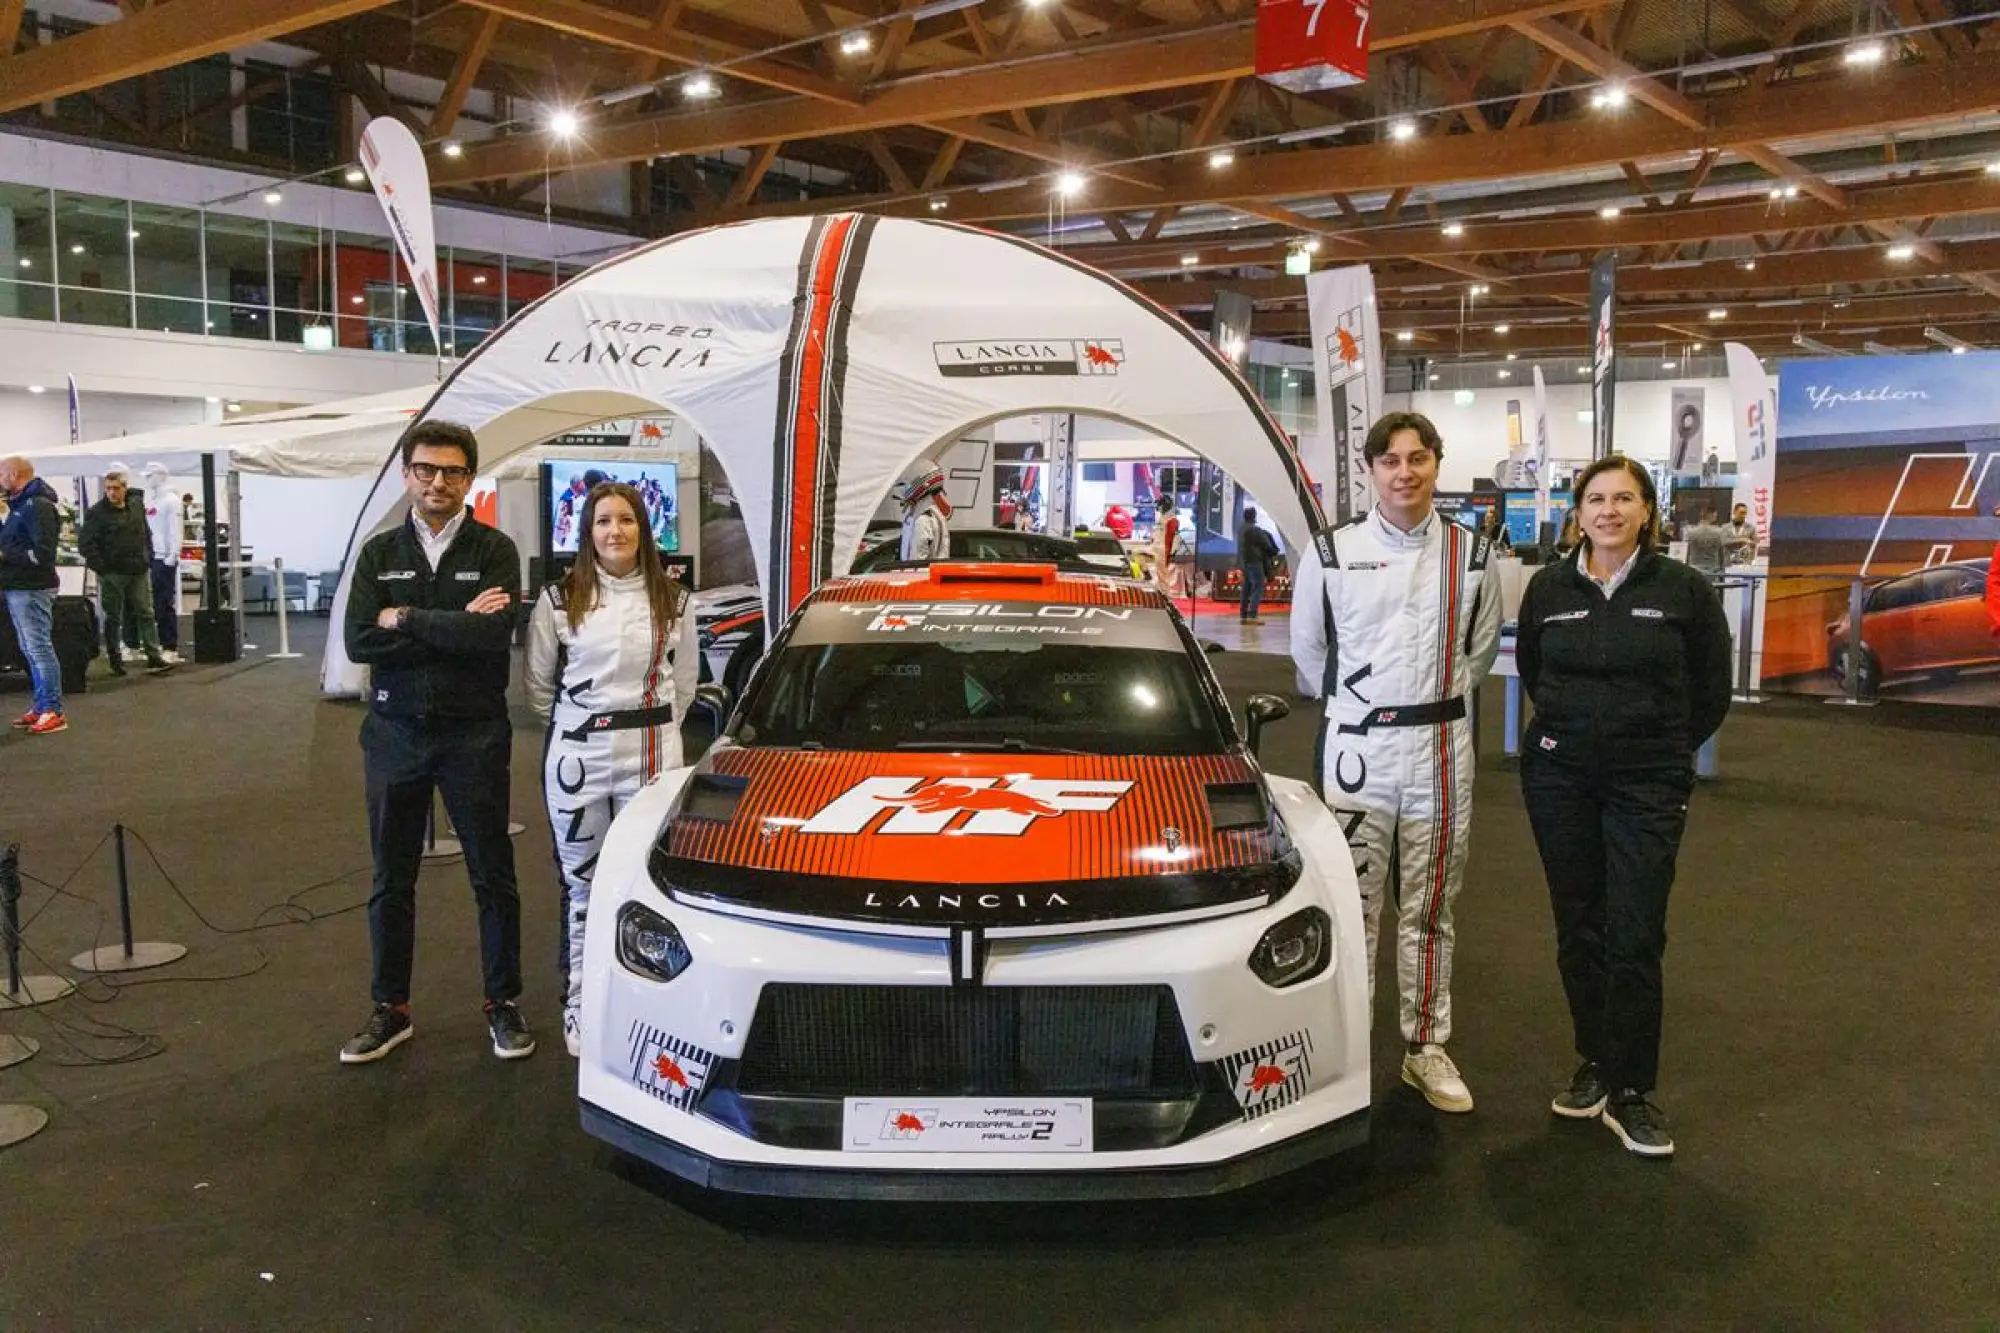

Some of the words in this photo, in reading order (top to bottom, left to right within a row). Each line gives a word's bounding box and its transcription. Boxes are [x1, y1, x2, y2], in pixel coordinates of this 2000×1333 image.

[1303, 0, 1325, 37] 7
[1355, 6, 1369, 48] 7
[587, 319, 714, 339] TROFEO
[544, 341, 711, 368] LANCIA
[956, 344, 1058, 361] LANCIA
[979, 364, 1045, 374] CORSE
[1805, 385, 1929, 411] Ypsilon
[840, 604, 1133, 620] YPSILON
[922, 624, 1105, 634] INTEGRALE
[865, 892, 1069, 907] LANCIA
[983, 1108, 1056, 1117] YPSILON
[938, 1120, 1032, 1129] INTEGRALE
[1031, 1122, 1055, 1140] 2
